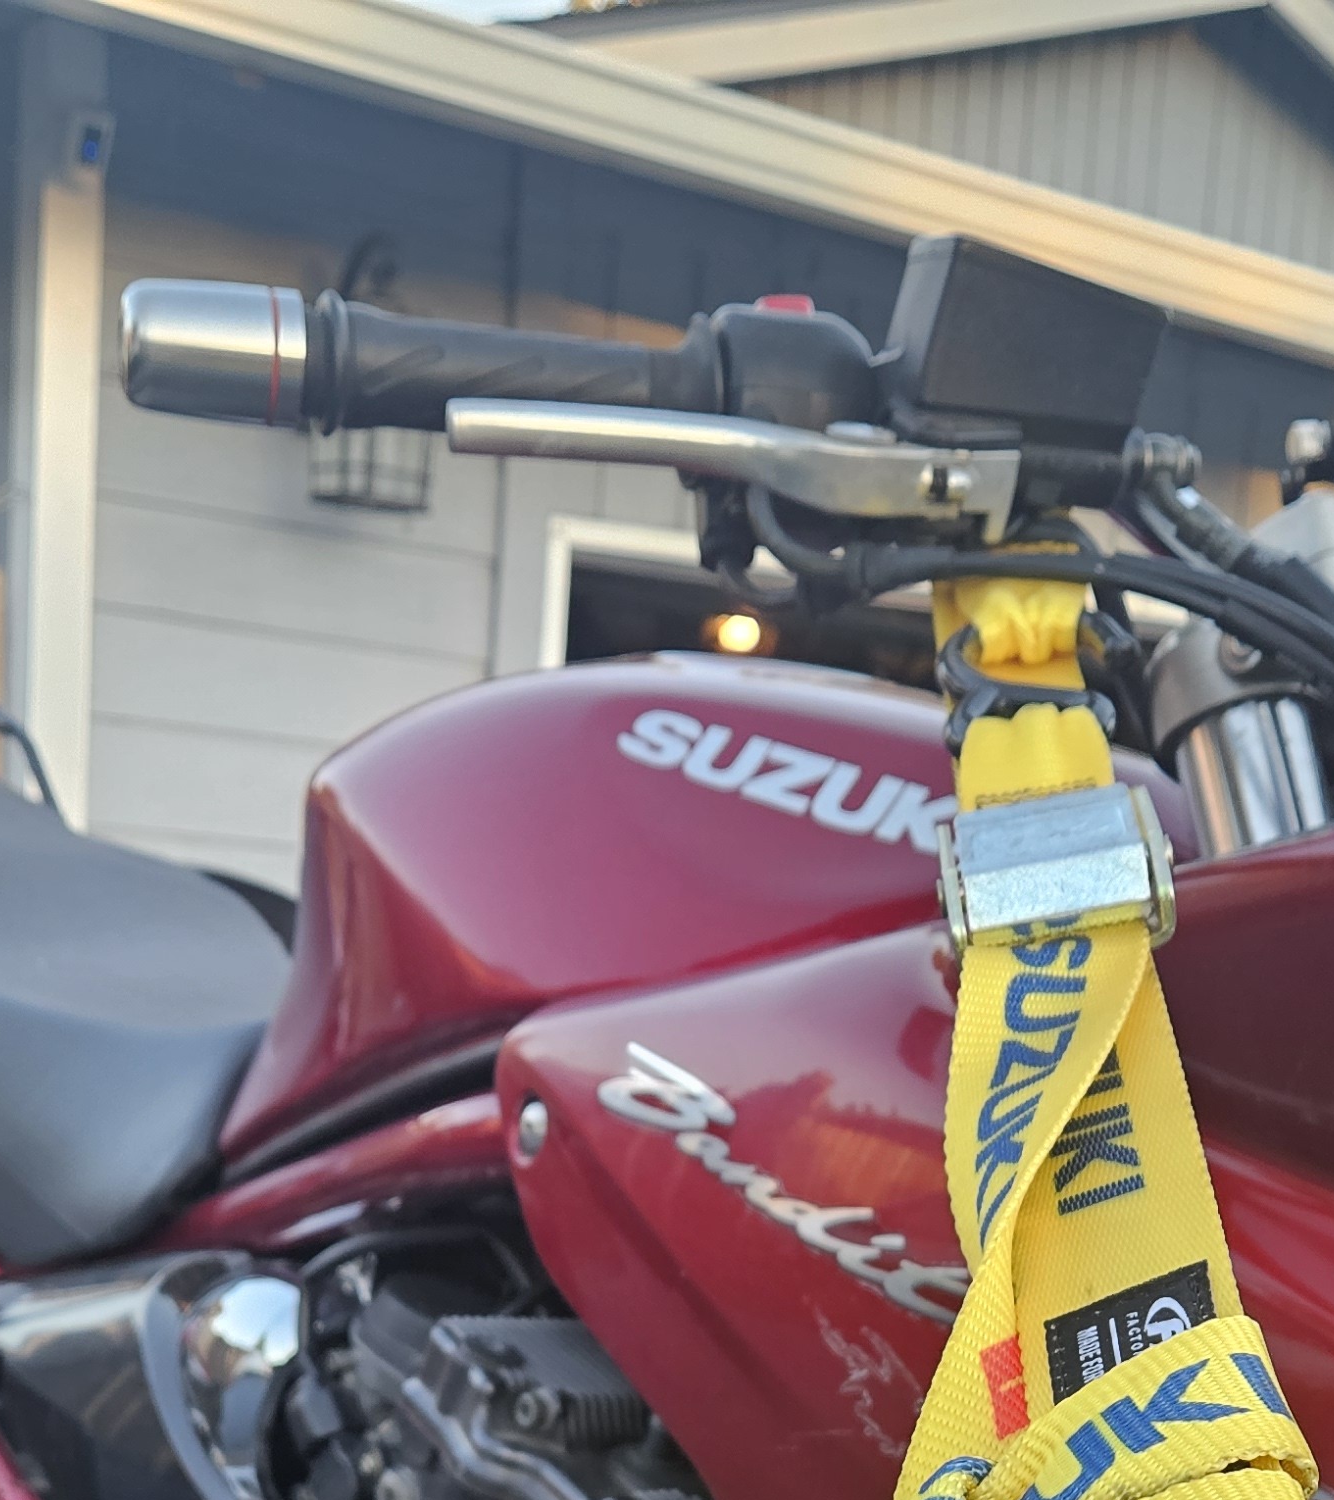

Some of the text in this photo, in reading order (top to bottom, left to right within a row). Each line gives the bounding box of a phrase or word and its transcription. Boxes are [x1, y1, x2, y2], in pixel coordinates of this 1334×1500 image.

[617, 709, 959, 855] SUZUK
[1077, 1325, 1101, 1361] MADE
[1125, 1311, 1143, 1356] FACTO
